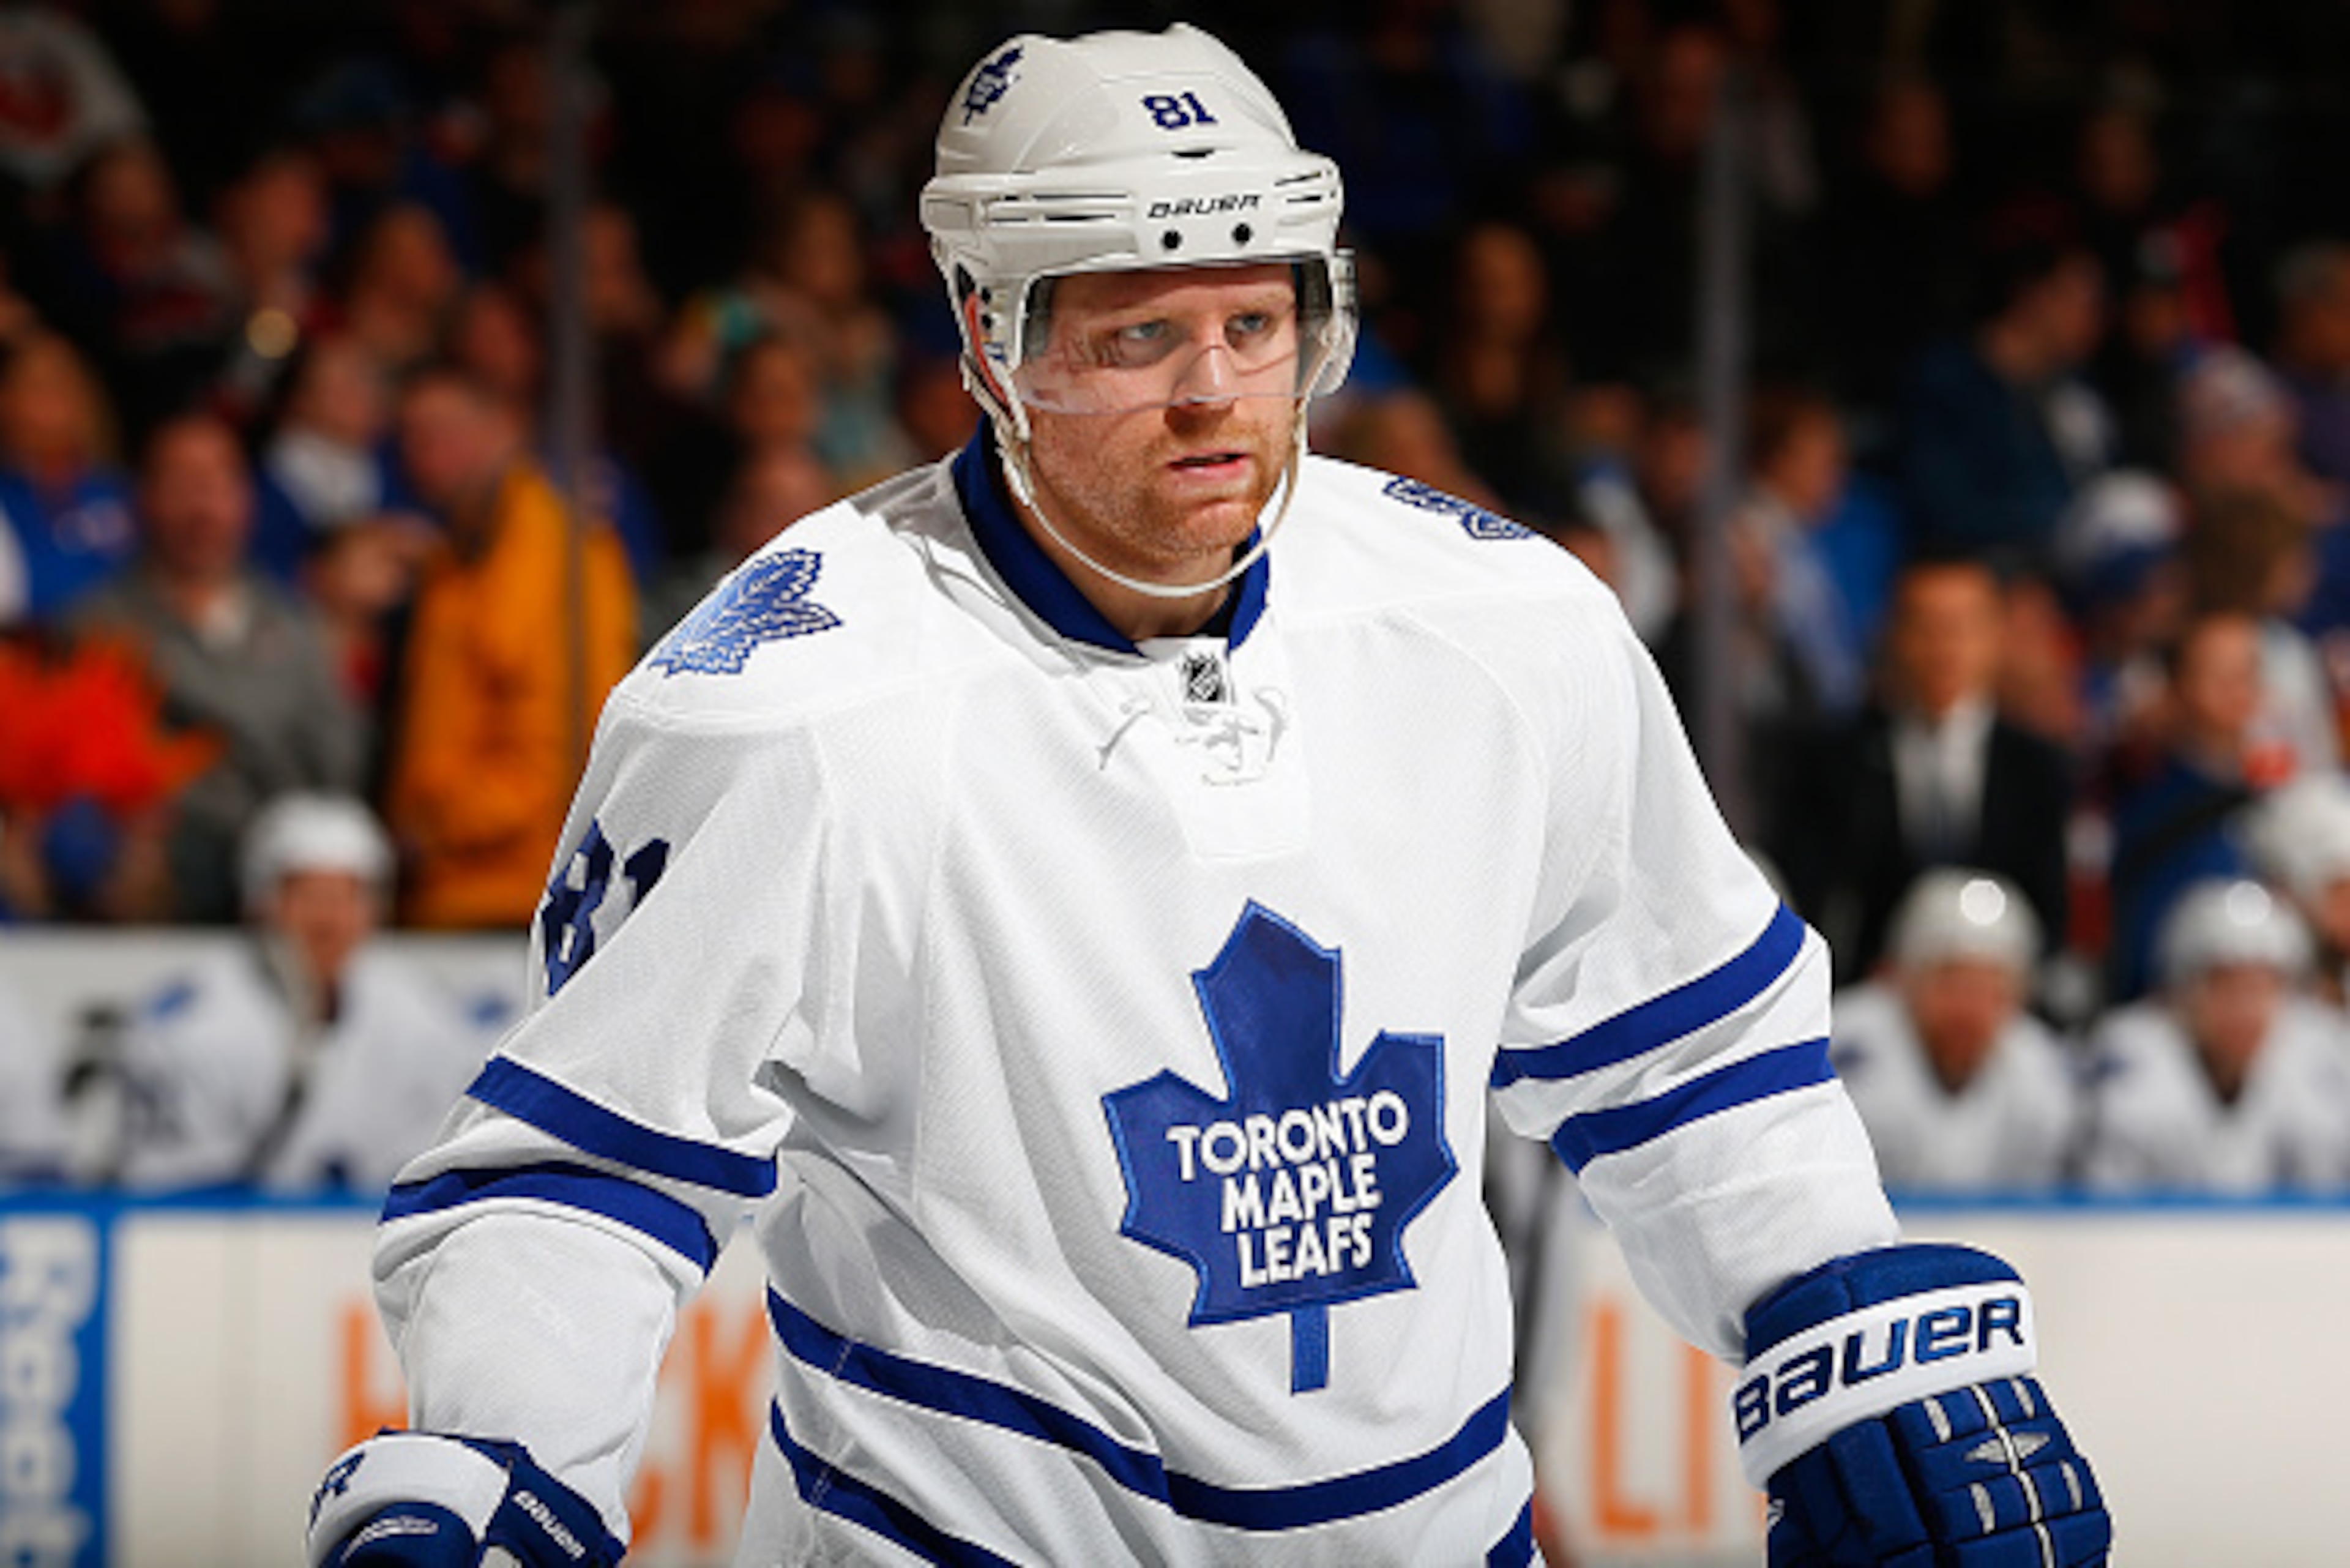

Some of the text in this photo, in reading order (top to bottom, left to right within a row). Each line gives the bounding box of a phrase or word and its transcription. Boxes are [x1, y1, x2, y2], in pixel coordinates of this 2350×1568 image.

[1141, 92, 1218, 129] 81
[1165, 1089, 1409, 1182] TORONTO
[1221, 1153, 1381, 1233] MAPLE
[1237, 1212, 1373, 1288] LEAFS
